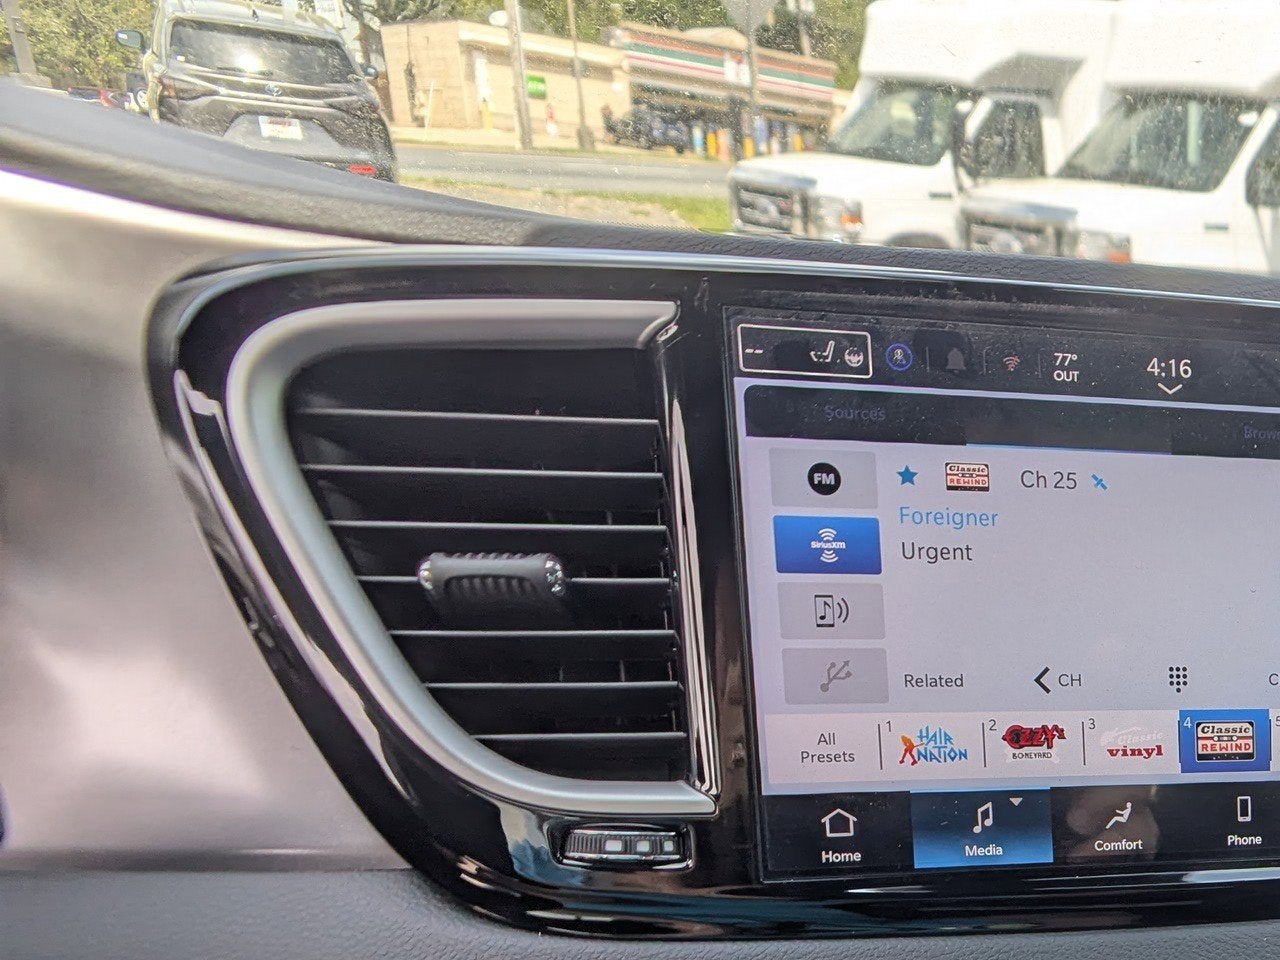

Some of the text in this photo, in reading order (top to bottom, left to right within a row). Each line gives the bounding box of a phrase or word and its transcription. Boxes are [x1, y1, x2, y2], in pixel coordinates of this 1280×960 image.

[1053, 352, 1078, 366] 77°
[1146, 357, 1192, 378] 4:16
[1053, 370, 1079, 383] OUT
[824, 405, 886, 421] Sources
[948, 465, 987, 473] Classic
[813, 472, 835, 485] FM
[1020, 470, 1078, 489] Ch 25
[899, 506, 999, 530] Foreigner
[901, 541, 973, 564] Urgent
[903, 673, 965, 688] Related
[1057, 673, 1082, 688] CH
[885, 720, 892, 732] 1
[988, 719, 998, 731] 2
[1087, 717, 1096, 730] 3
[1183, 716, 1193, 729] 4
[916, 725, 954, 746] HAIR
[1200, 725, 1250, 735] Classic
[816, 732, 837, 746] All
[1106, 744, 1164, 760] vinyl
[1201, 742, 1251, 752] REWIND
[800, 750, 855, 764] Presets
[916, 746, 968, 763] NATION
[1093, 839, 1143, 852] Comfort
[1227, 834, 1262, 846] Phone
[821, 850, 862, 864] Home
[964, 844, 1003, 858] Media
